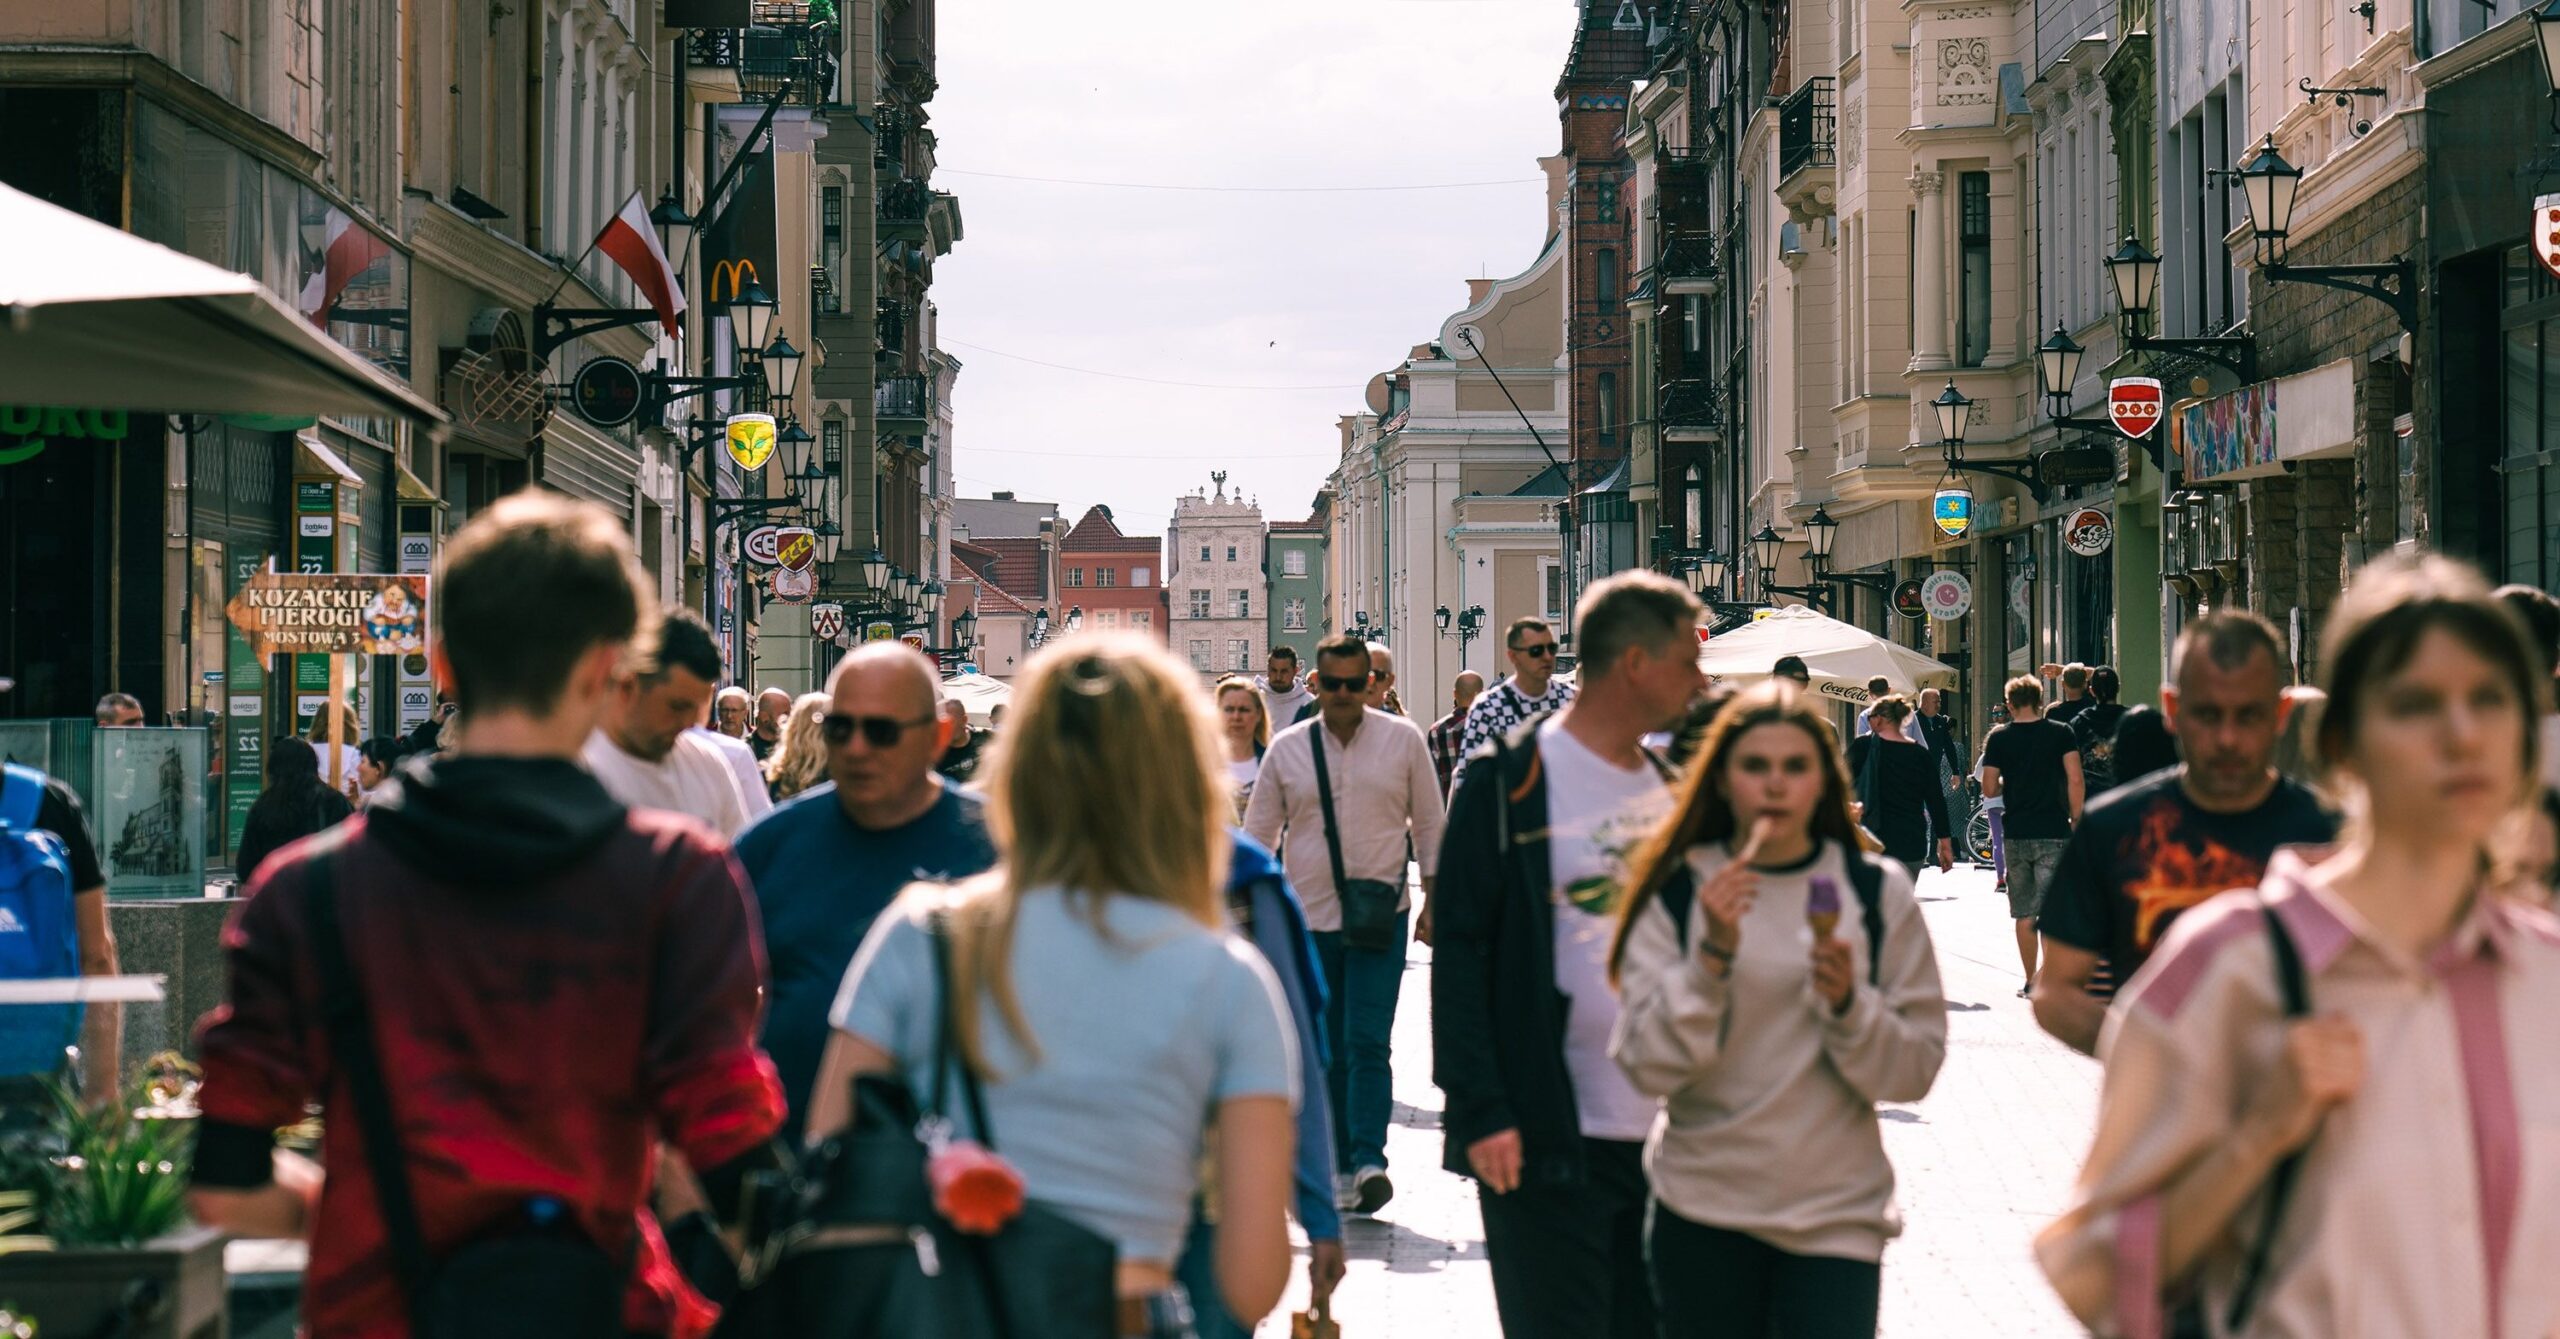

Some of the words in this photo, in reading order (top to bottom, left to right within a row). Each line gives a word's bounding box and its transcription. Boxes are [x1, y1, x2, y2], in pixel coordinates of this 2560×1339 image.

[1943, 574, 1969, 593] FACTORY
[249, 589, 374, 608] KOZACKIE
[261, 608, 361, 626] PIEROGI
[1933, 608, 1960, 617] STORE
[264, 631, 347, 645] MOSTOWA
